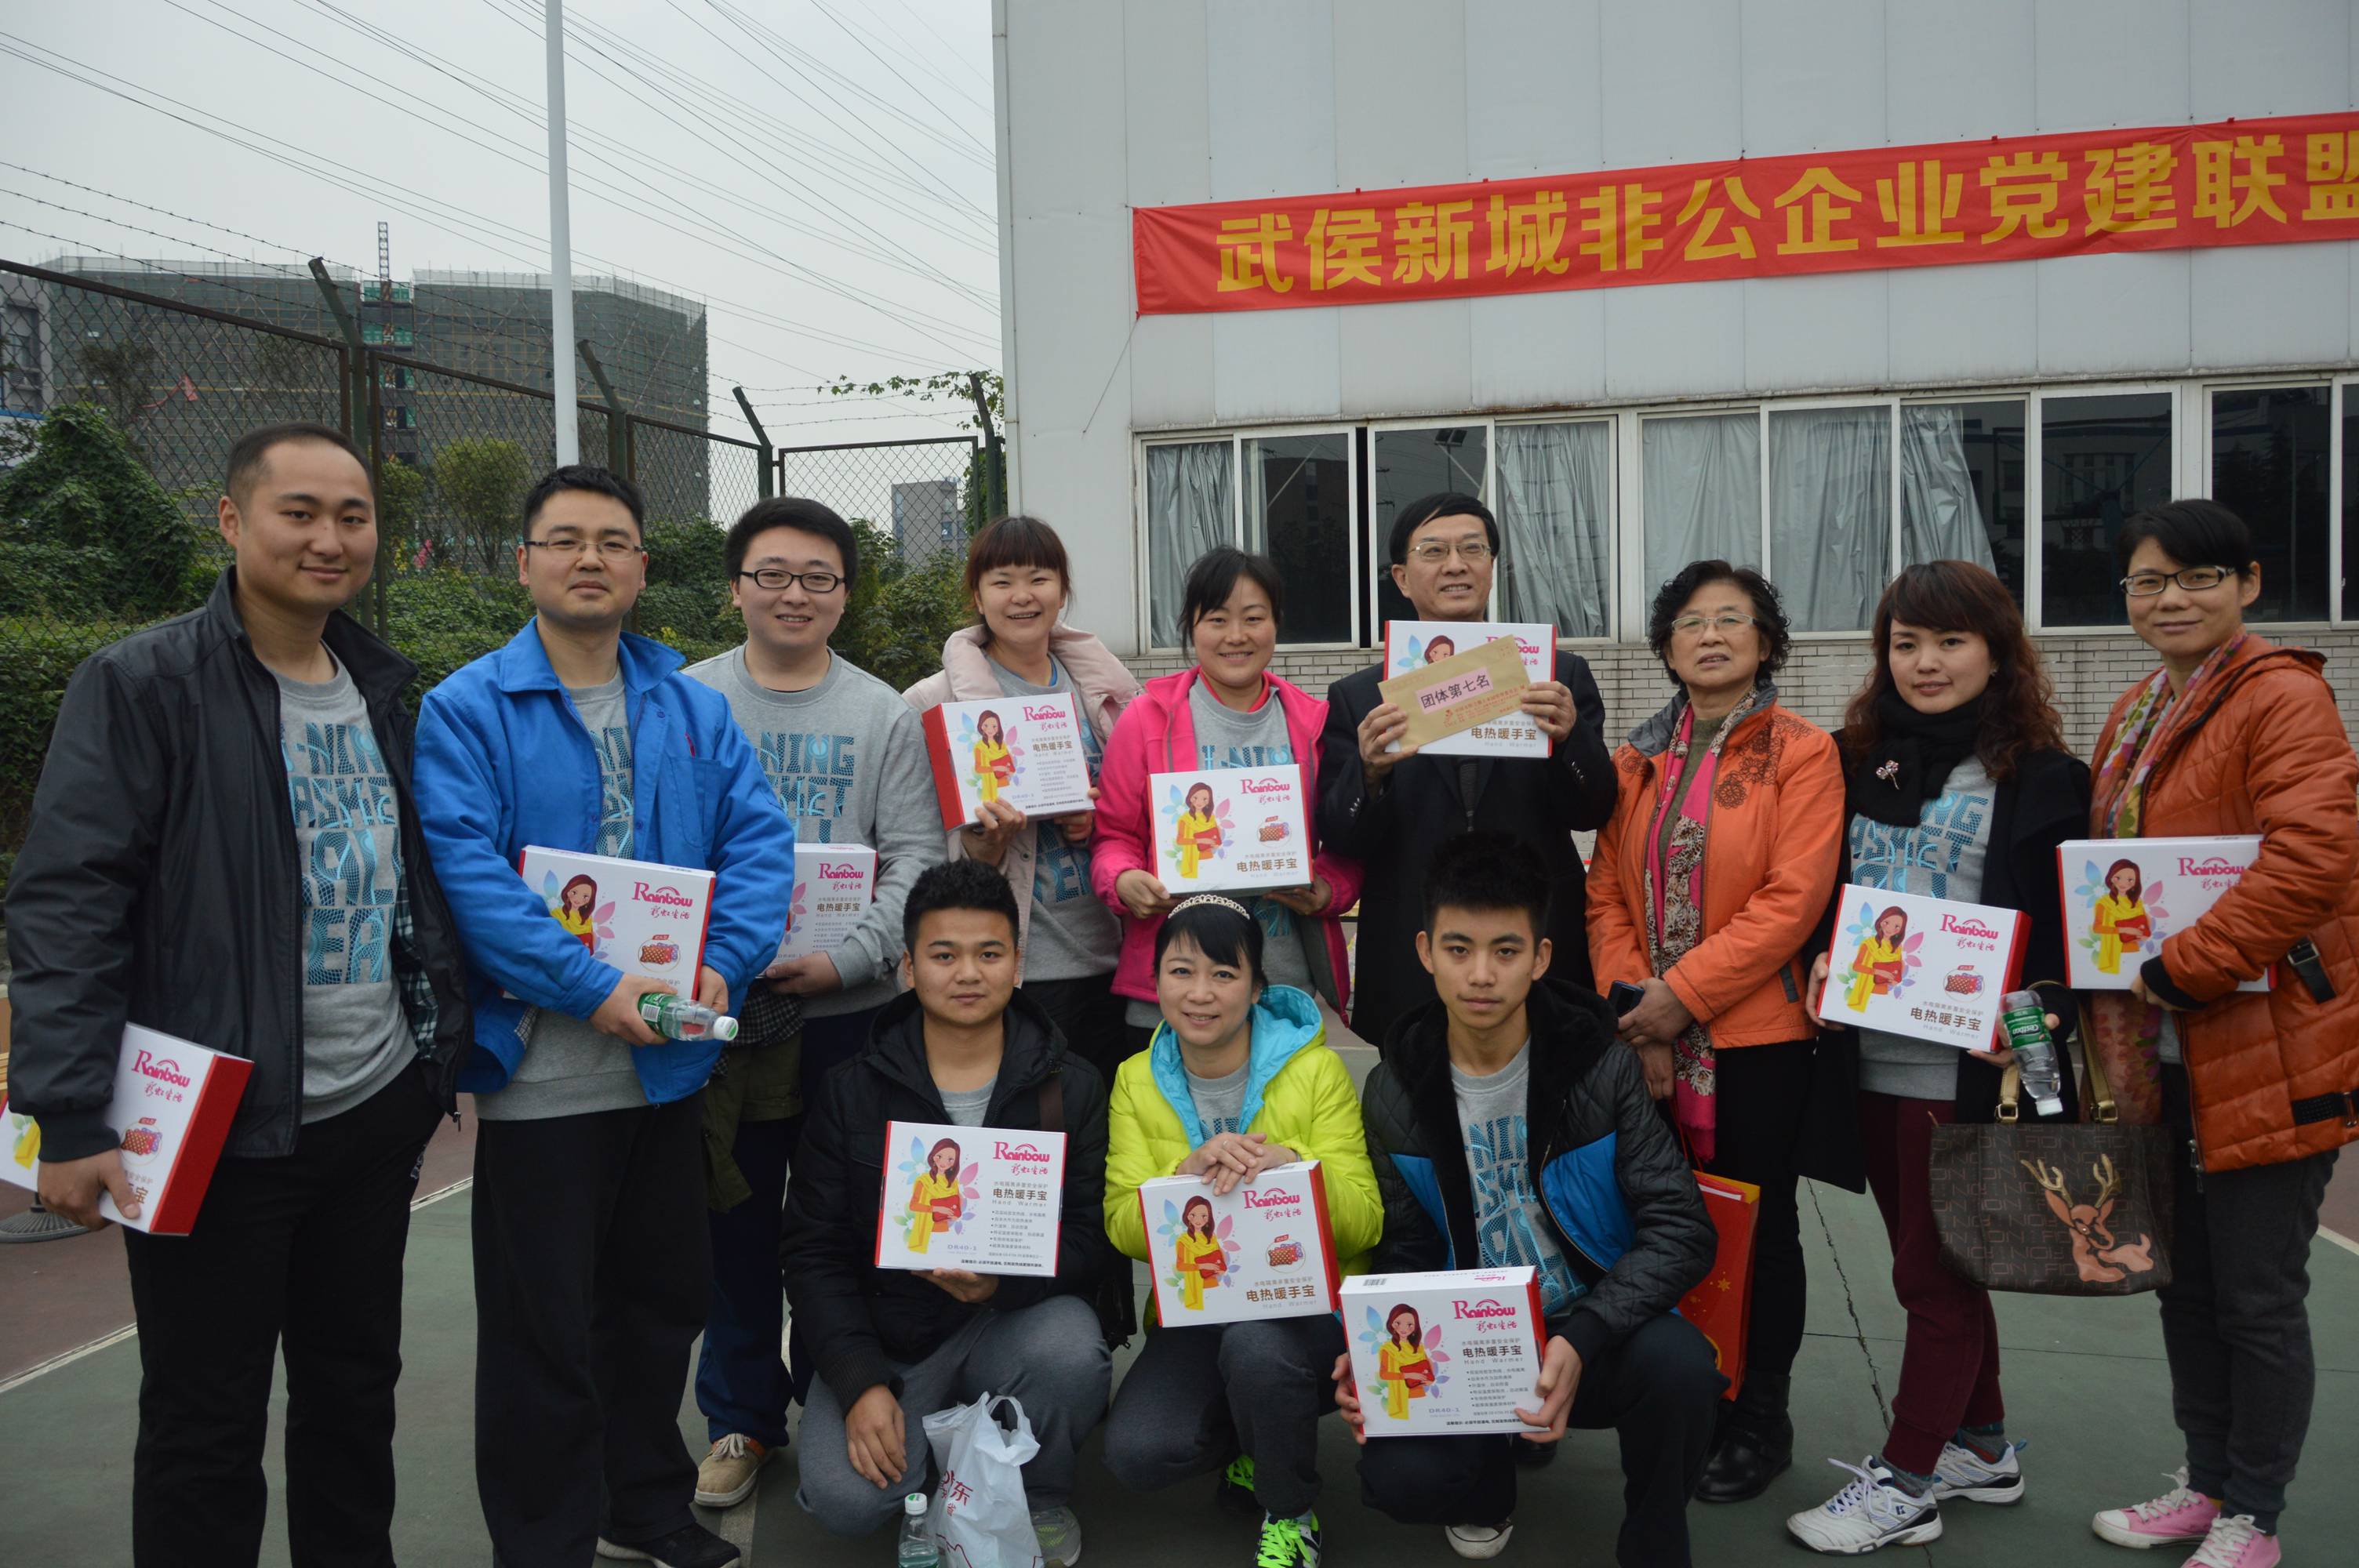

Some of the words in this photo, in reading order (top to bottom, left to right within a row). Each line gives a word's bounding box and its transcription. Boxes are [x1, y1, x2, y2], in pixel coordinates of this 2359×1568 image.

[1216, 130, 2359, 294] 武侯新城非公企业党建联盟
[1420, 674, 1490, 709] 团体第七名
[1023, 705, 1067, 721] Rainbow
[1471, 727, 1537, 740] 电热暖手宝
[1033, 740, 1073, 752] 电热暖手宝
[1240, 777, 1291, 794] Rainbow
[818, 862, 864, 879] Rainbow
[1237, 858, 1298, 873] 电热暖手宝
[2177, 857, 2245, 877] Rainbow
[632, 881, 693, 907] Rainbow
[816, 902, 860, 912] 电热暖手宝
[1939, 913, 1999, 940] Rainbow
[1910, 1007, 1982, 1032] 电热暖手宝
[132, 1049, 191, 1088] Rainbow
[993, 1142, 1051, 1163] Rainbow
[993, 1188, 1048, 1201] 电热暖手宝
[1242, 1188, 1301, 1209] Rainbow
[1246, 1284, 1316, 1302] 电热暖手宝
[1452, 1298, 1517, 1319] Rainbow
[1463, 1345, 1522, 1358] 电热暖手宝
